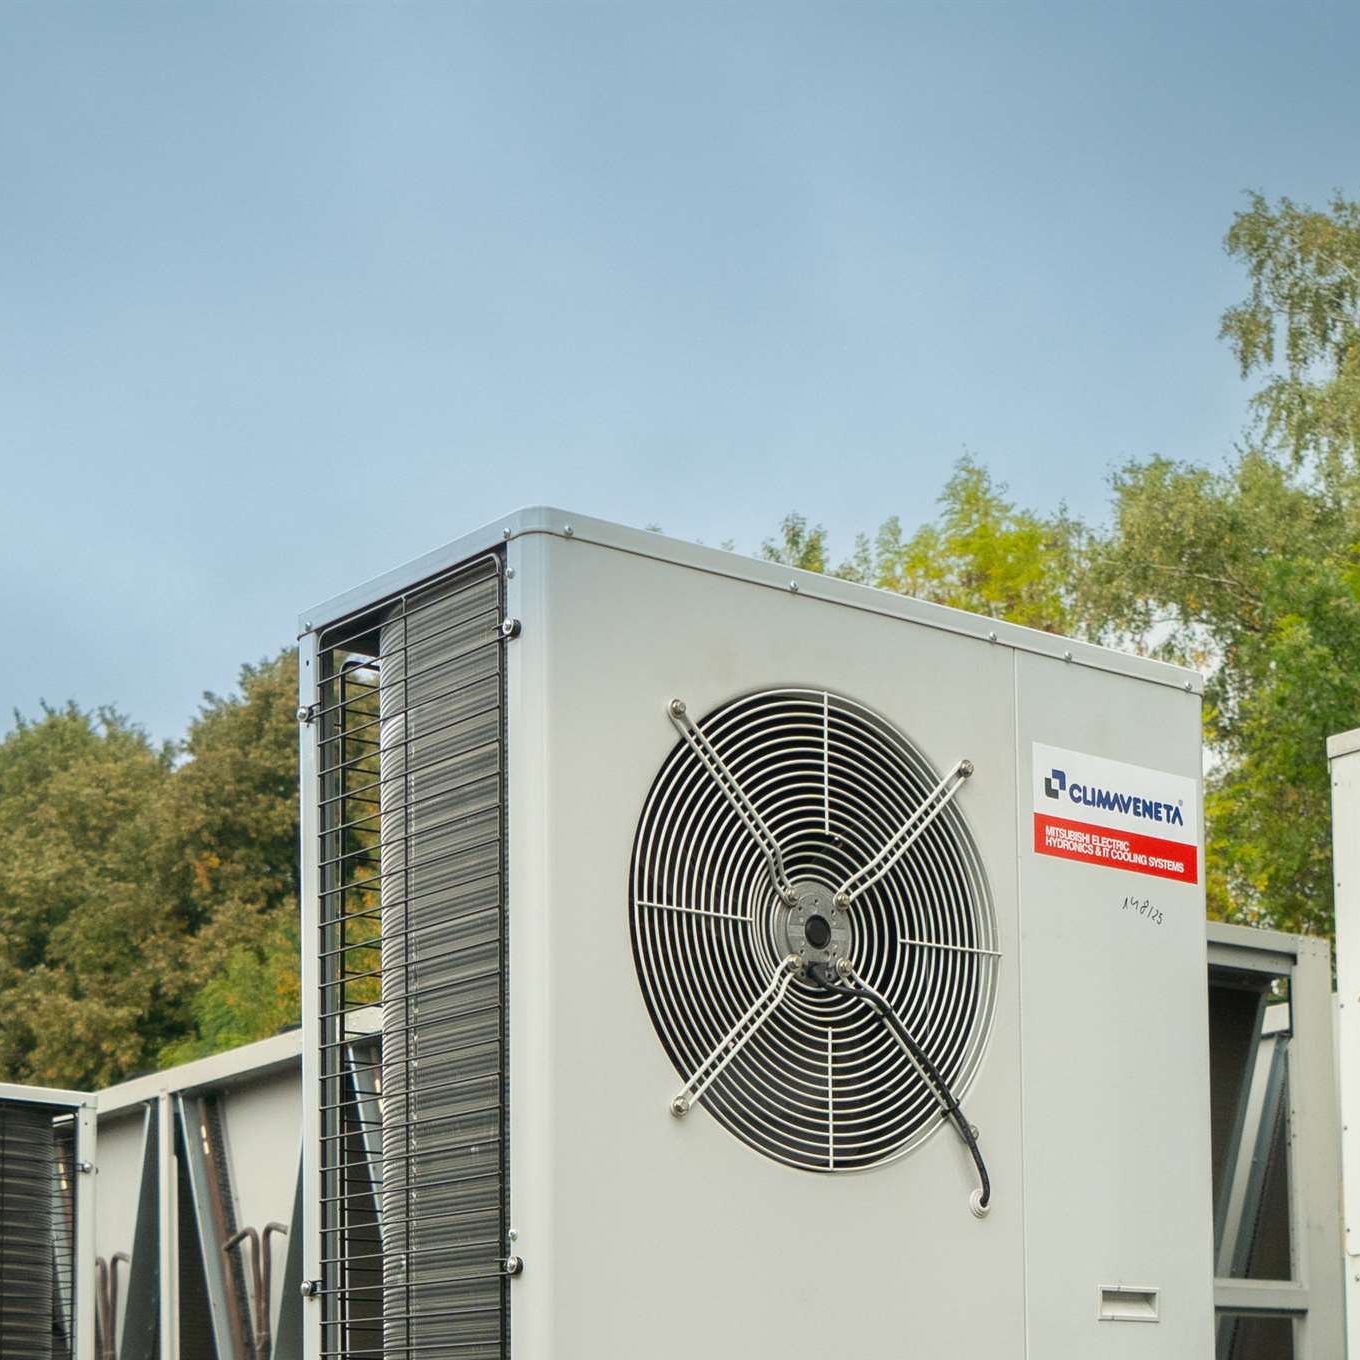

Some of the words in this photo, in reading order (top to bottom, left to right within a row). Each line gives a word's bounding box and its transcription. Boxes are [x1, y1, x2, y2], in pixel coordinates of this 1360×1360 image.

[1069, 783, 1184, 826] CLIMAVENETA
[1045, 825, 1091, 844] MITSUBISHI
[1092, 834, 1130, 852] ELECTRIC
[1045, 838, 1094, 856] HYDRONICS
[1095, 847, 1103, 857] &
[1102, 849, 1110, 859] IT
[1111, 850, 1148, 866] COOLING
[1148, 857, 1185, 873] SYSTEMS
